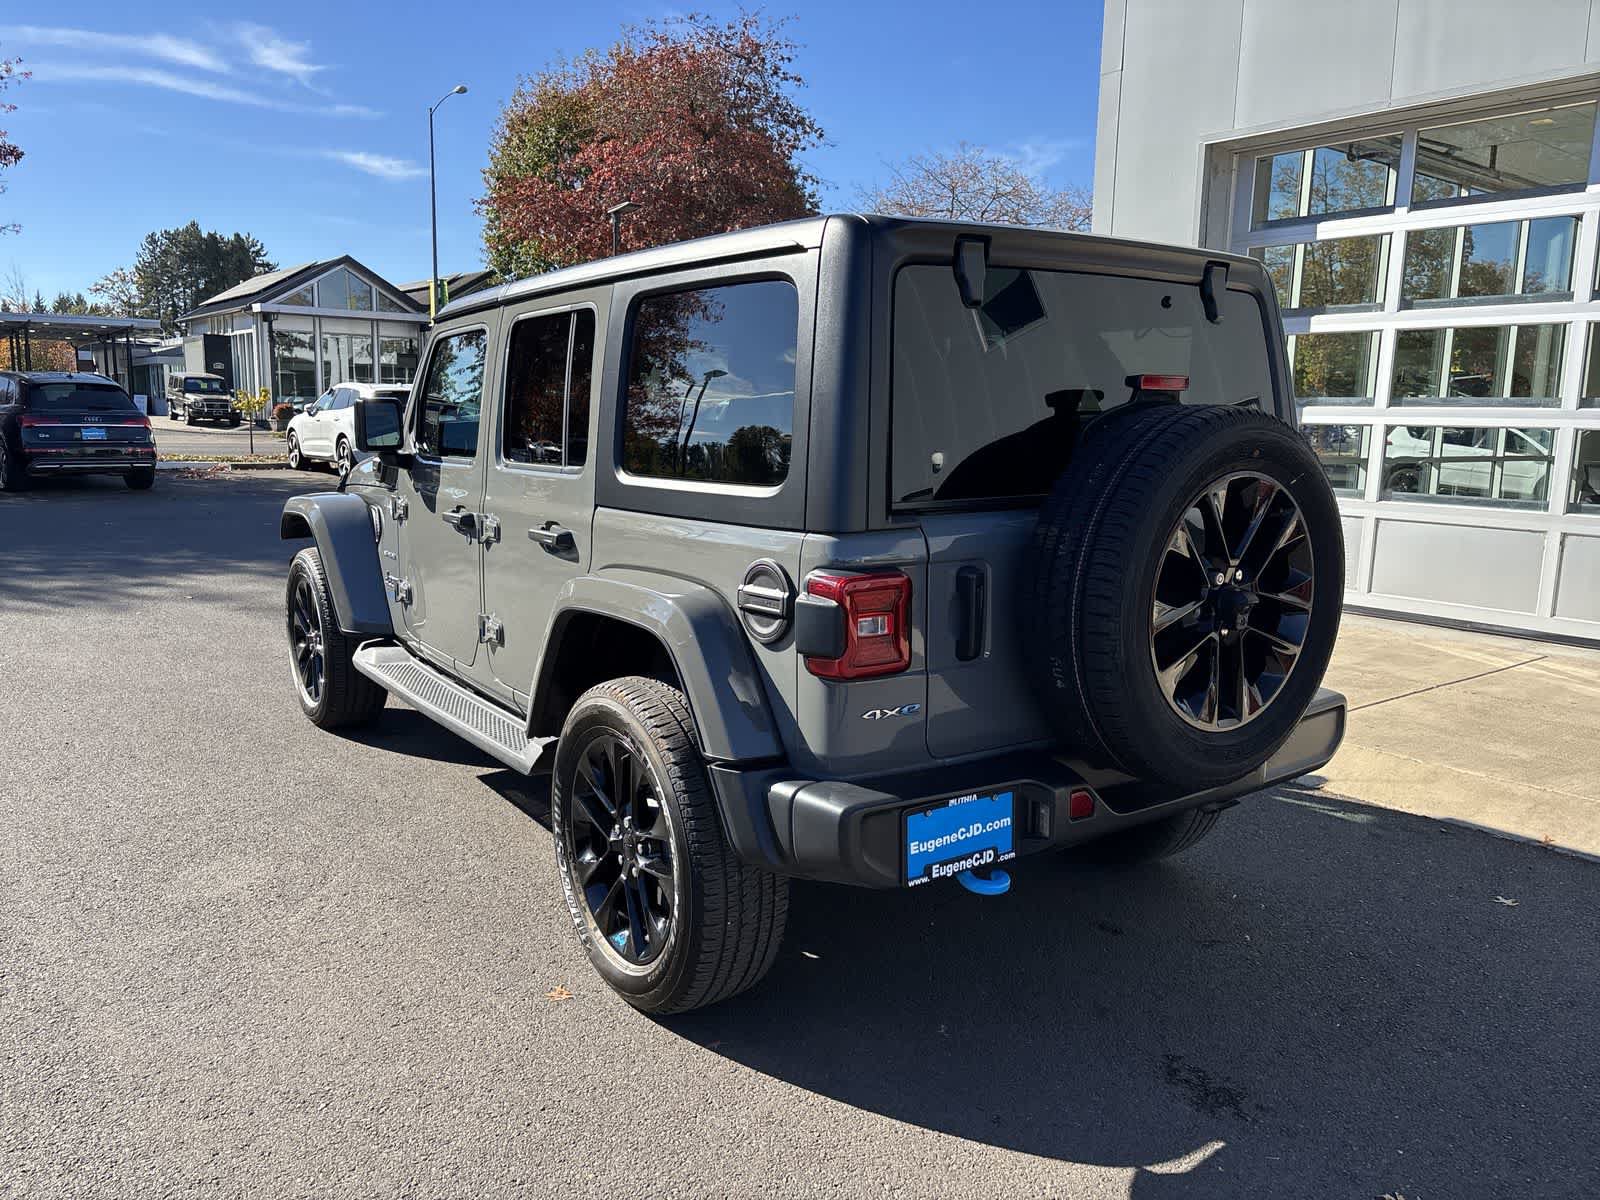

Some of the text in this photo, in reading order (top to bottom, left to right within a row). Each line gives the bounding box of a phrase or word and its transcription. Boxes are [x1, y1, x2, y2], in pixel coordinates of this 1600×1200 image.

[910, 817, 1011, 855] EugeneCJD.com
[908, 849, 1016, 887] www. EugeneCJD .com
